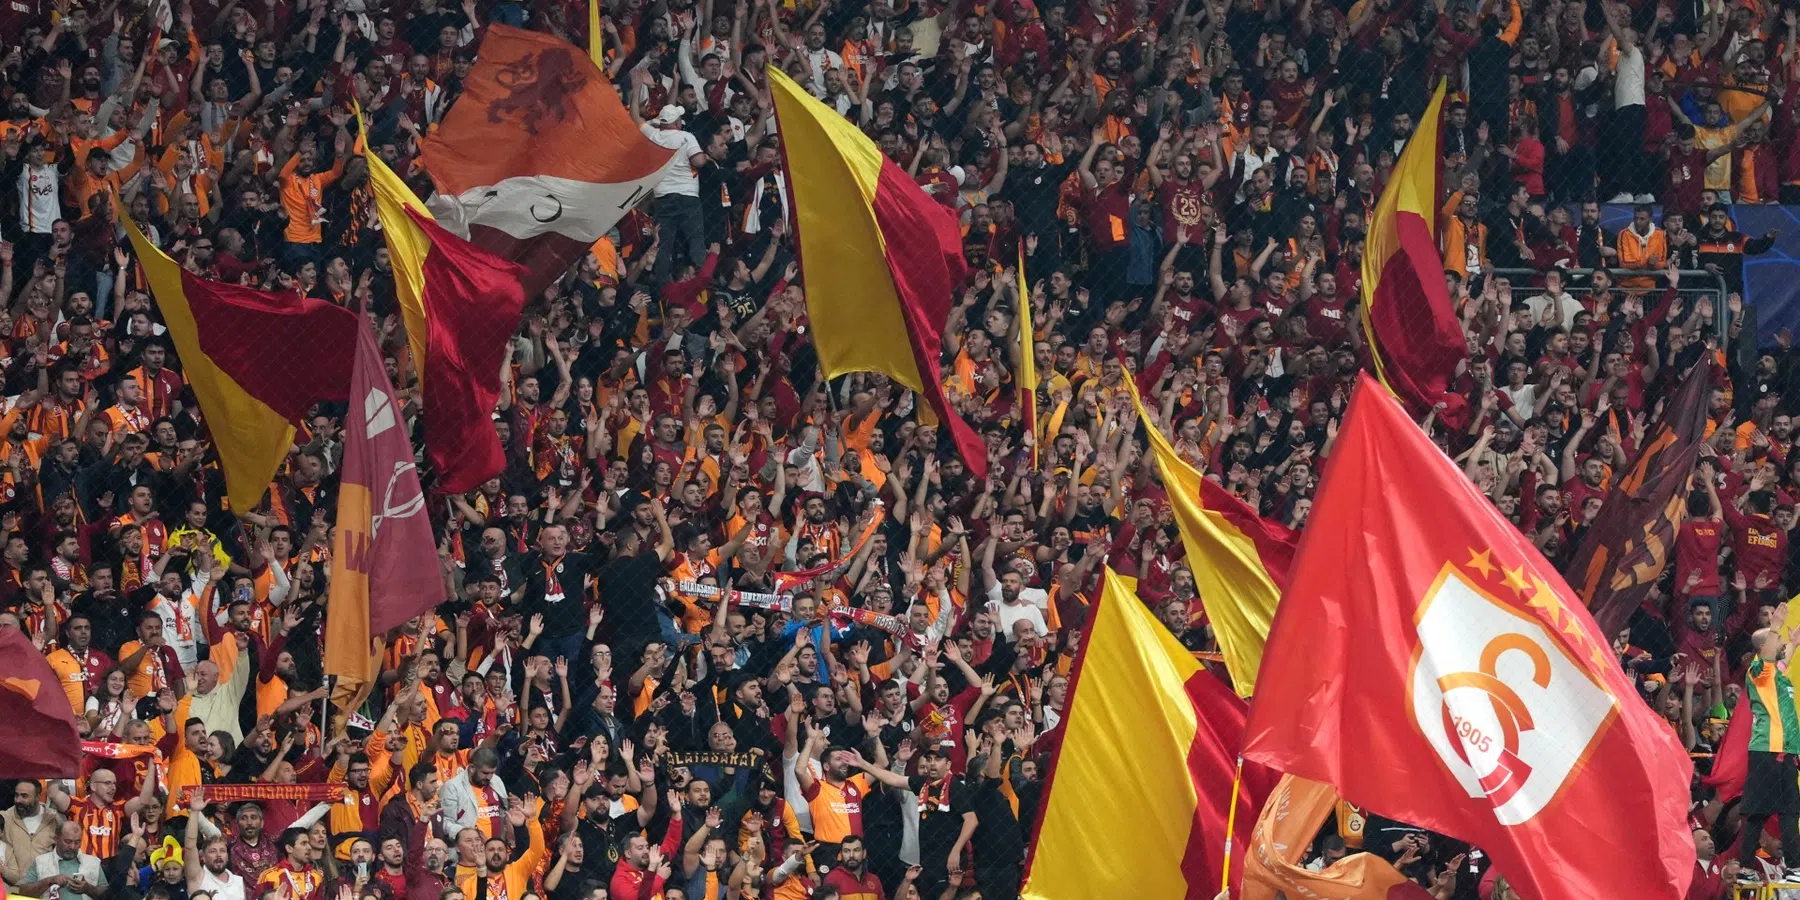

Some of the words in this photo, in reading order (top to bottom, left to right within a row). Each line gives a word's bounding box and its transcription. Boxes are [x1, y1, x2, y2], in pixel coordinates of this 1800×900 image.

[1180, 198, 1197, 216] 25
[1454, 716, 1493, 753] 1905
[666, 751, 757, 767] ALATASARAY
[214, 786, 311, 801] GALATASARAY
